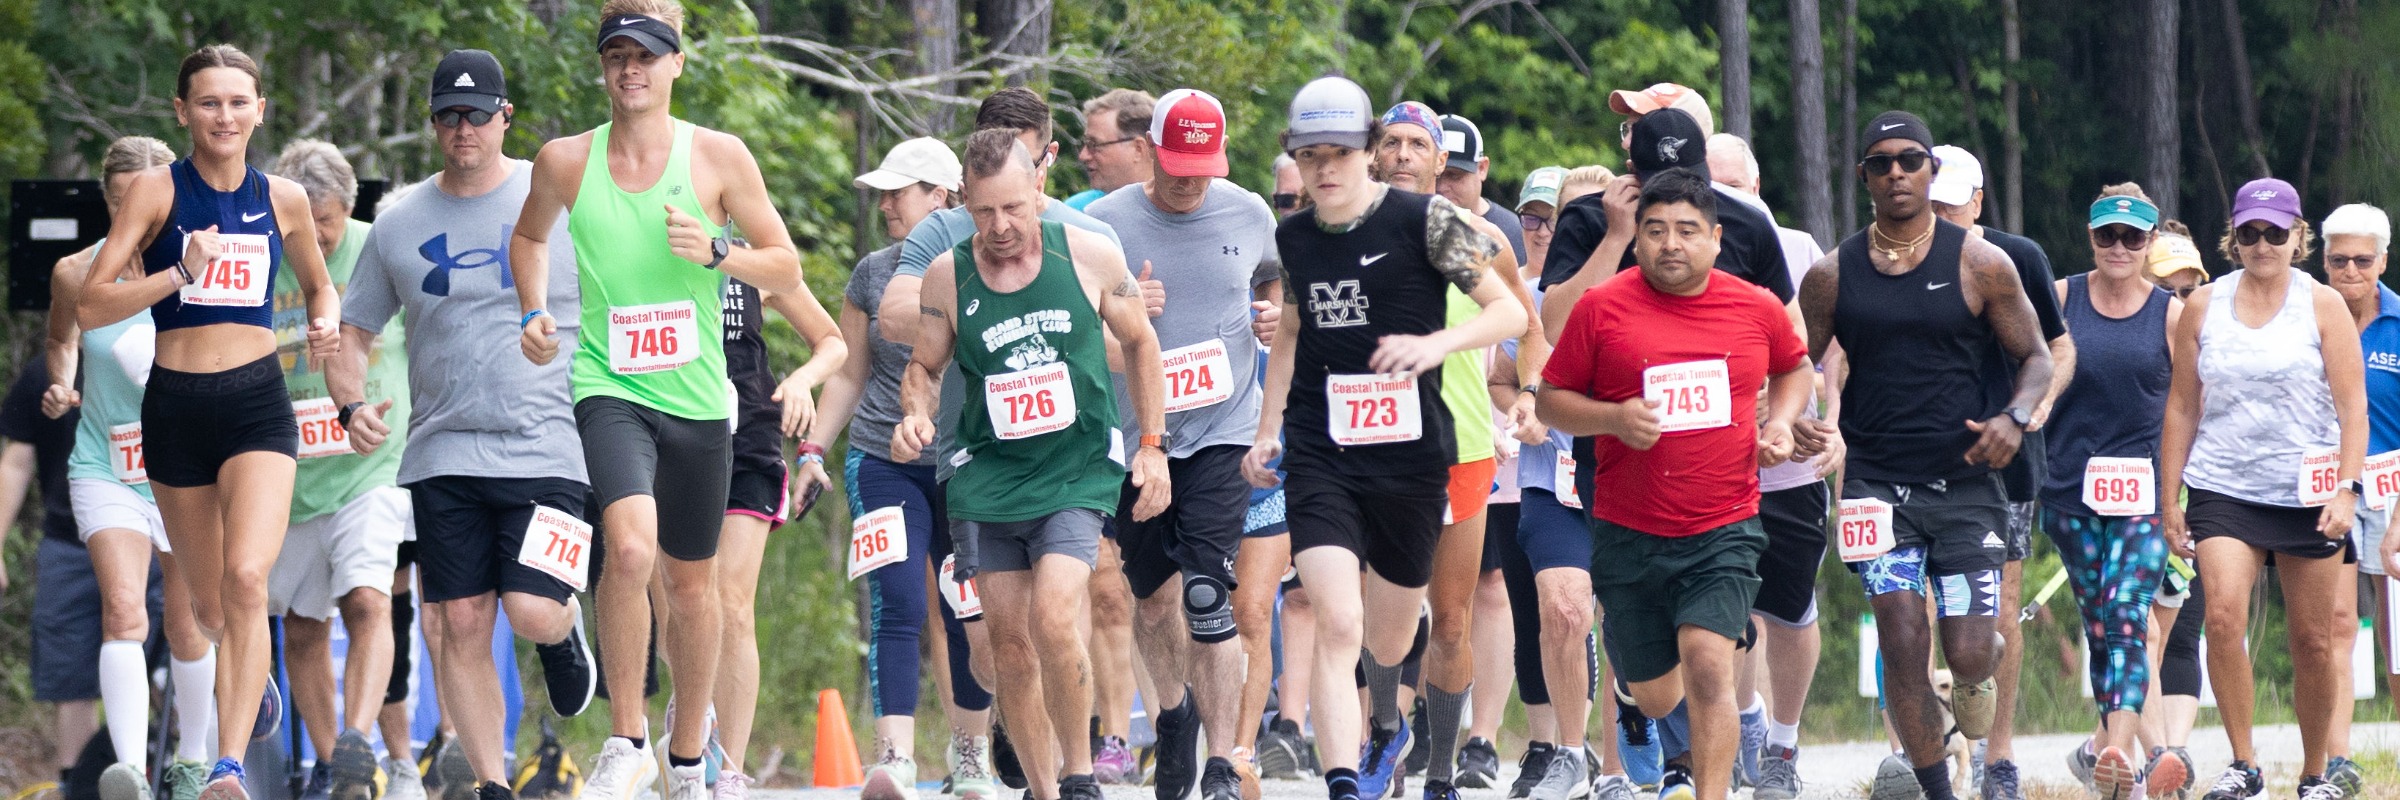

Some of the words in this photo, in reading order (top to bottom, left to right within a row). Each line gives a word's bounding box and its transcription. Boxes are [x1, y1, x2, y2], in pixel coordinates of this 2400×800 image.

[232, 242, 265, 255] Timing
[728, 284, 743, 295] EE
[612, 312, 652, 325] Coastal
[654, 308, 691, 322] Timing
[1314, 299, 1361, 311] MARSHALL
[982, 317, 1022, 342] GRAND
[1024, 309, 1071, 324] STRAND
[986, 323, 1039, 353] RUNNING
[1041, 321, 1072, 333] CLUB
[626, 327, 678, 359] 746
[1163, 354, 1187, 368] astal
[1188, 347, 1222, 361] Timing
[990, 377, 1026, 393] Coastal
[1028, 370, 1064, 386] Timing
[1165, 364, 1214, 398] 724
[1332, 382, 1372, 394] Coastal
[1375, 379, 1412, 392] Timing
[1650, 371, 1686, 385] Coastal
[1689, 369, 1723, 379] Timing
[1003, 389, 1055, 424] 726
[1346, 397, 1399, 429] 723
[1663, 385, 1710, 415] 743
[302, 418, 344, 445] 678
[120, 444, 146, 471] 72
[2088, 464, 2118, 473] Coastal
[2121, 464, 2150, 474] Timing
[2364, 457, 2396, 471] Coastal
[2094, 478, 2139, 502] 693
[2312, 467, 2340, 493] 56
[2376, 470, 2400, 497] 60
[537, 512, 572, 533] Coastal
[574, 526, 592, 543] Timi
[854, 521, 868, 533] stal
[1843, 520, 1877, 547] 673
[544, 531, 582, 569] 714
